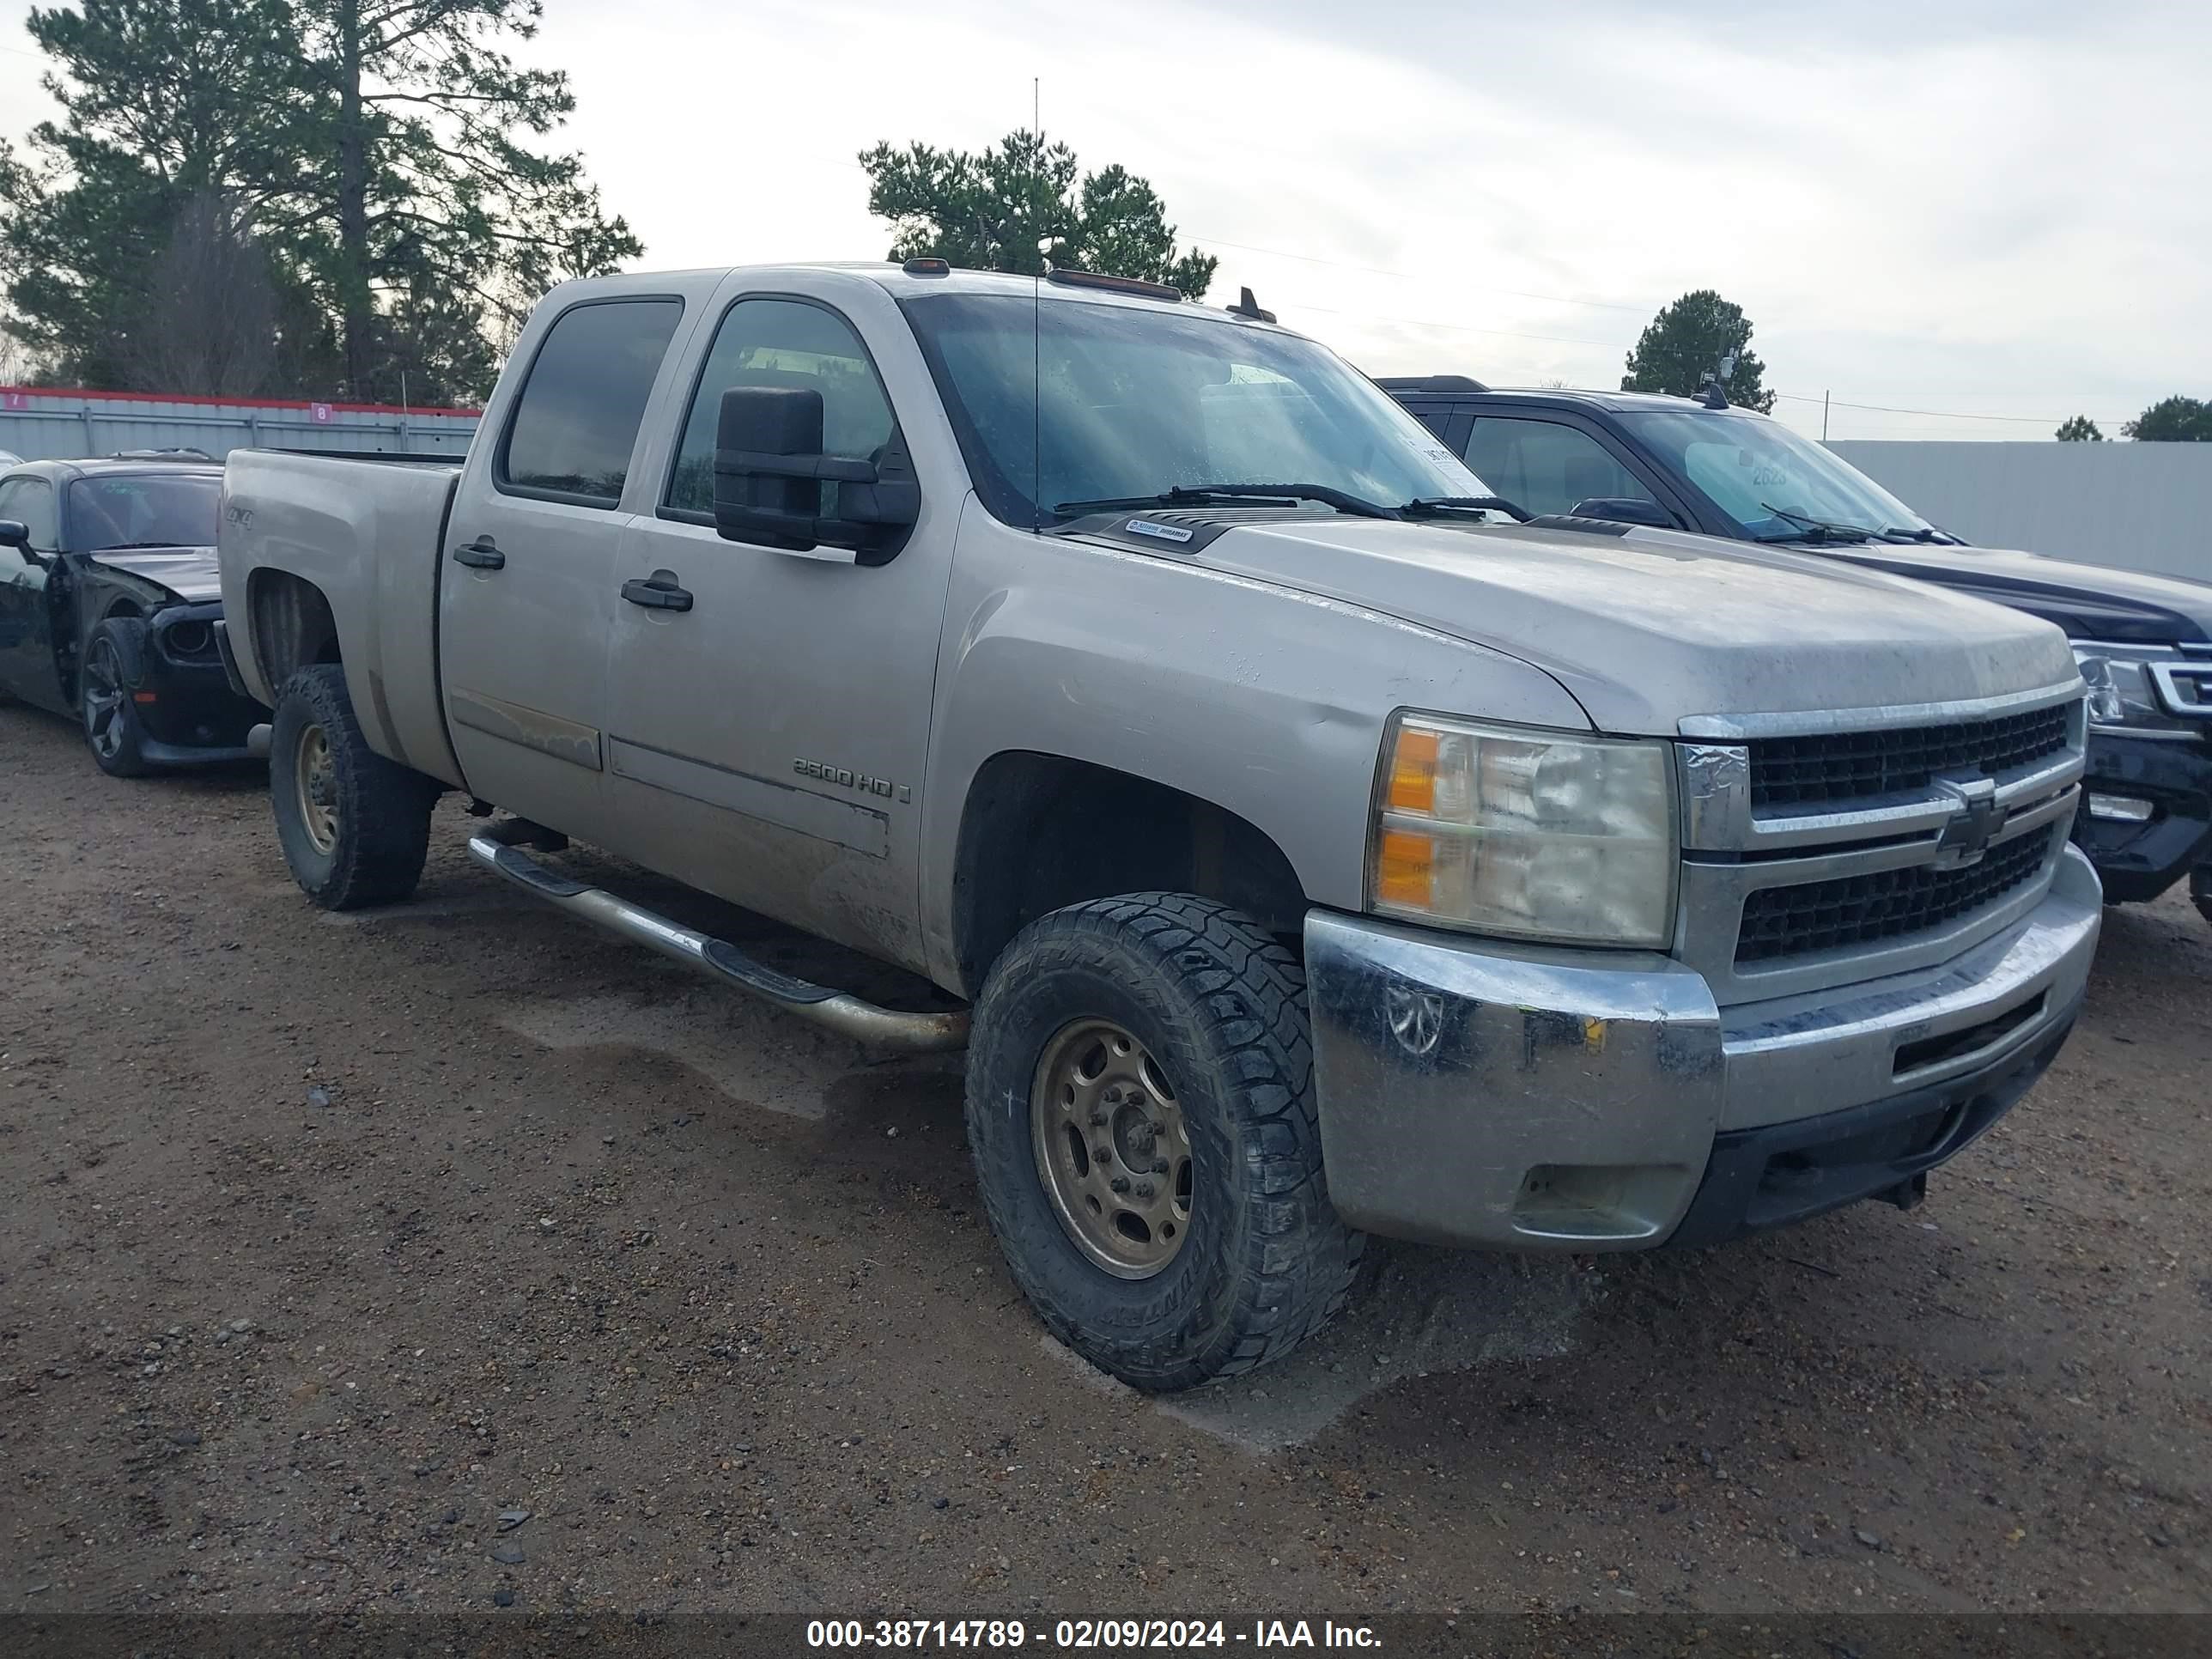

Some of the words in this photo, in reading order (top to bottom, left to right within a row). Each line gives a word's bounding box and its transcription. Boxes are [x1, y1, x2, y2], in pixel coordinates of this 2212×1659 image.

[9, 393, 19, 406] 7
[317, 407, 326, 420] 8
[793, 757, 854, 787] 2500
[859, 774, 892, 798] HD
